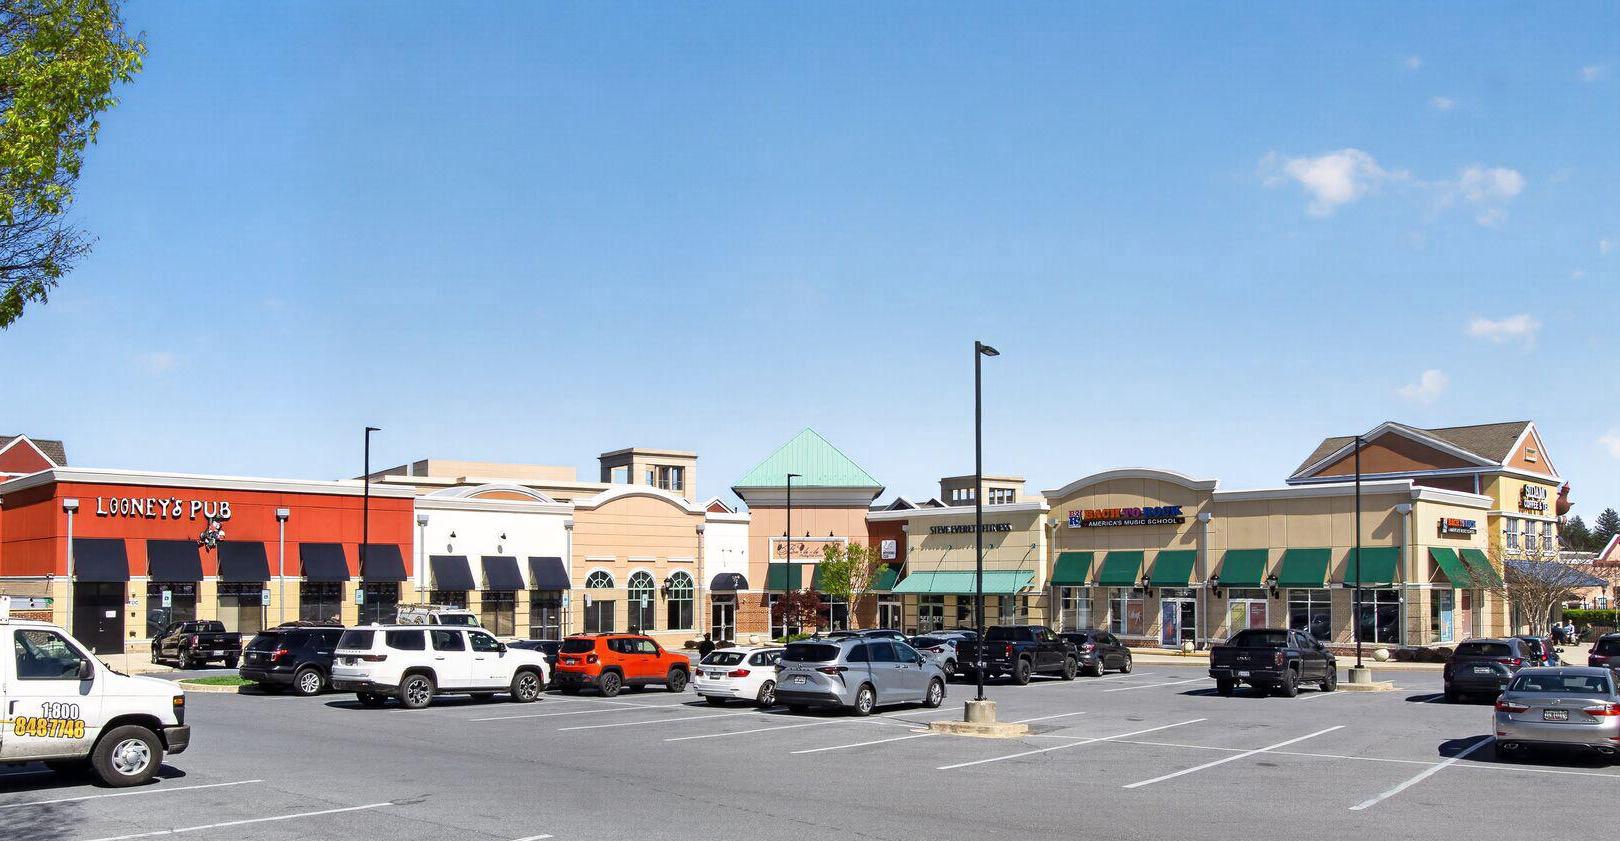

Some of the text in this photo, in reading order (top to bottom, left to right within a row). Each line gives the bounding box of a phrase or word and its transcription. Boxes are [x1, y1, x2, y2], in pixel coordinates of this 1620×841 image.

[96, 496, 232, 520] LOONEY'S PUB
[1088, 518, 1122, 528] AMERICA'S
[1123, 517, 1146, 526] MUSIC
[1147, 517, 1178, 525] SCHOOL
[930, 525, 950, 535] STEVE
